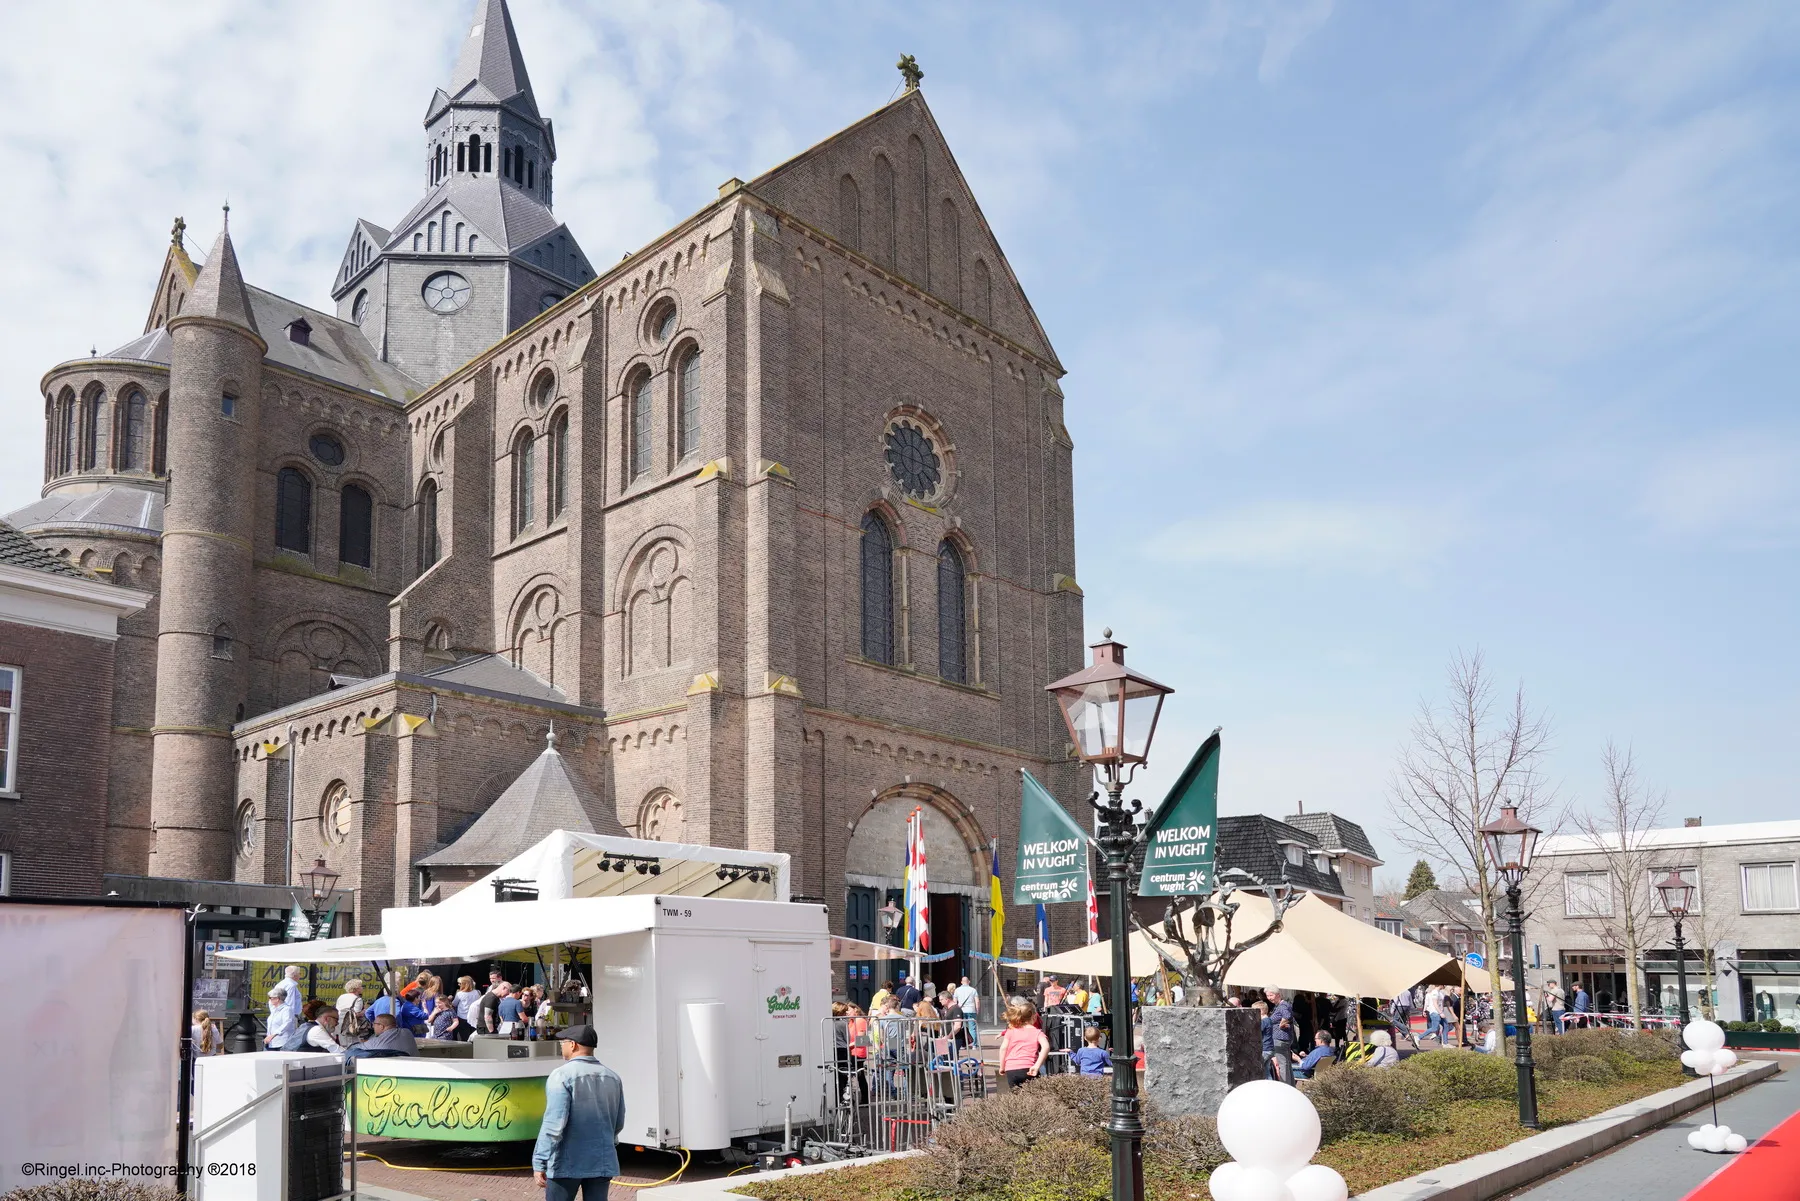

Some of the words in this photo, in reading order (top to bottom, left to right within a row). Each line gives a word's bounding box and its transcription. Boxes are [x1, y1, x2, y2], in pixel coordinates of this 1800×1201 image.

[1156, 824, 1211, 844] WELKOM
[1023, 838, 1079, 856] WELKOM
[1154, 846, 1167, 859] IN
[1167, 842, 1208, 858] VUGHT
[1022, 858, 1035, 870] IN
[1036, 853, 1077, 869] VUGHT
[1150, 873, 1186, 883] centrum
[1020, 882, 1058, 892] centrum
[1159, 881, 1186, 893] vught
[662, 908, 679, 917] TWM
[684, 909, 692, 918] 59
[766, 995, 800, 1014] Grolsch
[362, 1076, 512, 1136] Grolsch
